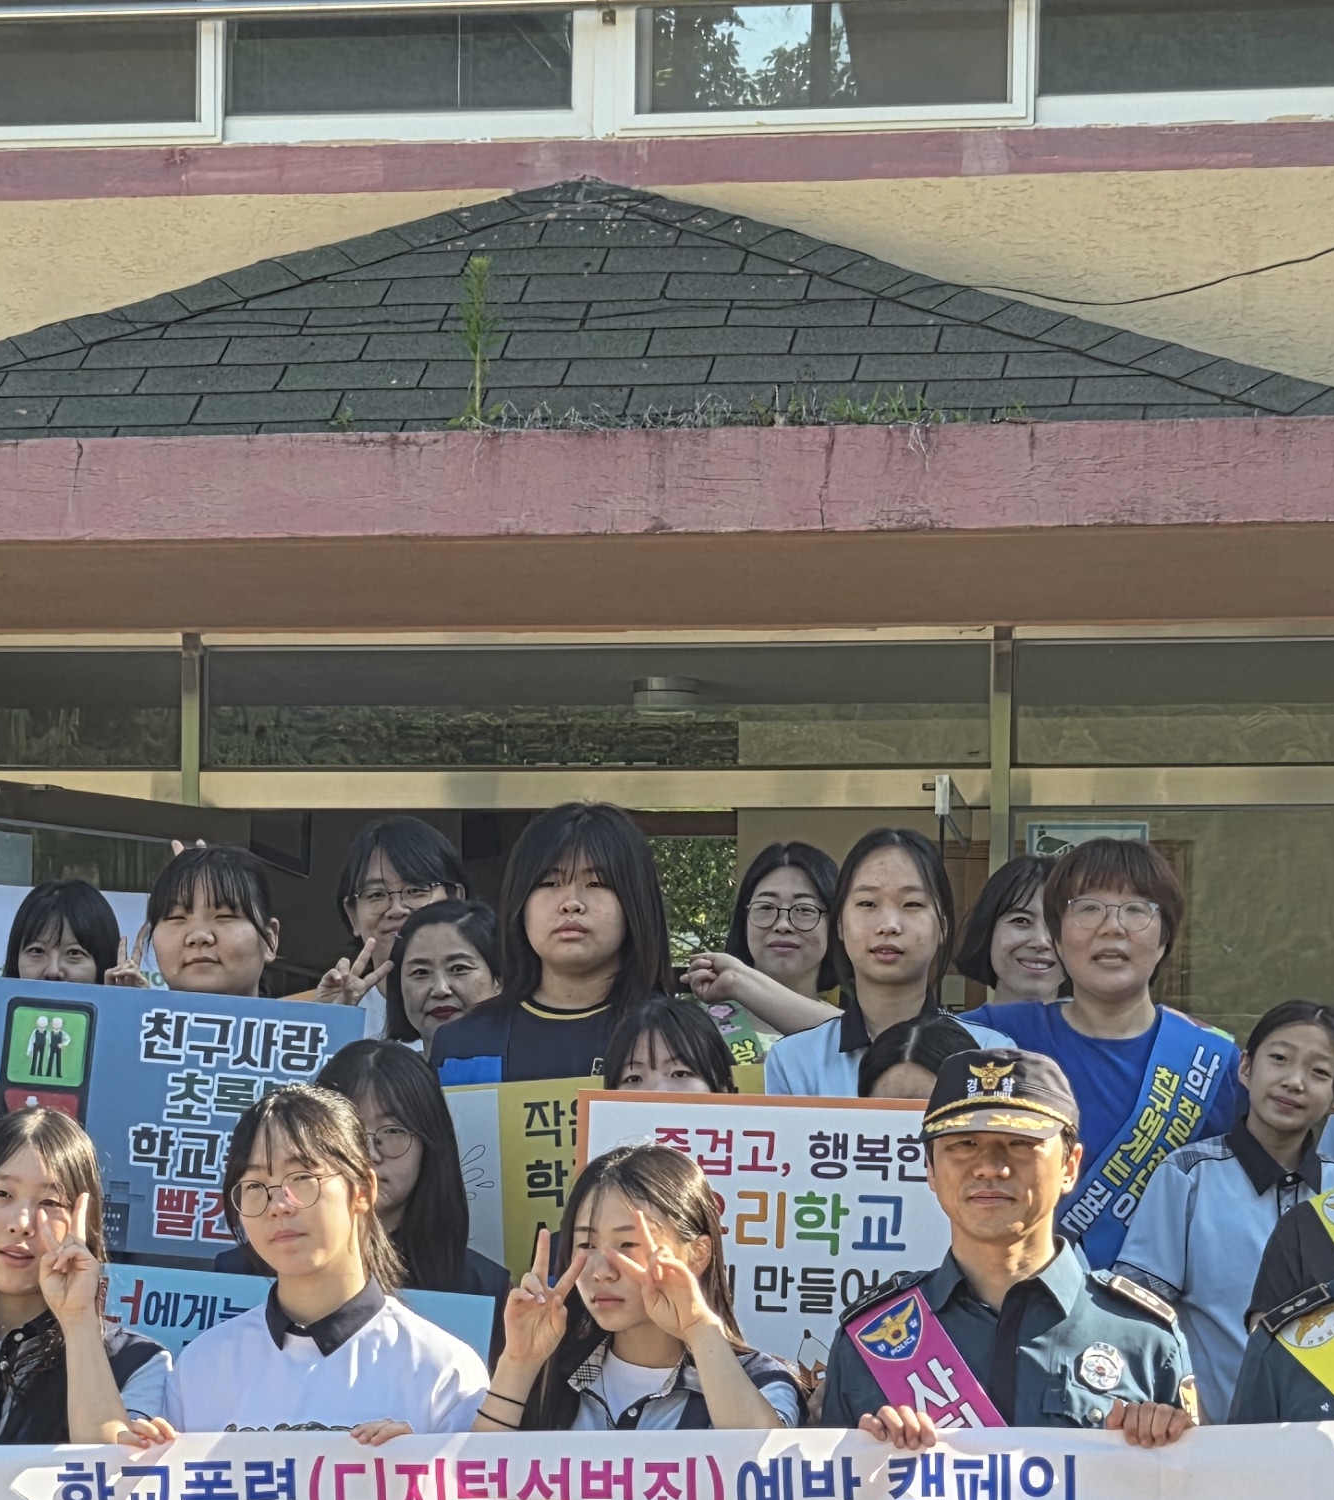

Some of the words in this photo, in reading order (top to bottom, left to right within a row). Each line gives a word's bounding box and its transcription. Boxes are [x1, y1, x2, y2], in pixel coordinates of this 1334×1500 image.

[167, 1072, 279, 1124] 초록
[1184, 1045, 1220, 1101] 나의
[1101, 1064, 1181, 1188] 친구에게는
[1164, 1095, 1203, 1149] 작은
[131, 1126, 233, 1181] 학교
[808, 1130, 928, 1183] 행복한
[1060, 1179, 1113, 1235] 깊은
[890, 1334, 917, 1357] POLICE
